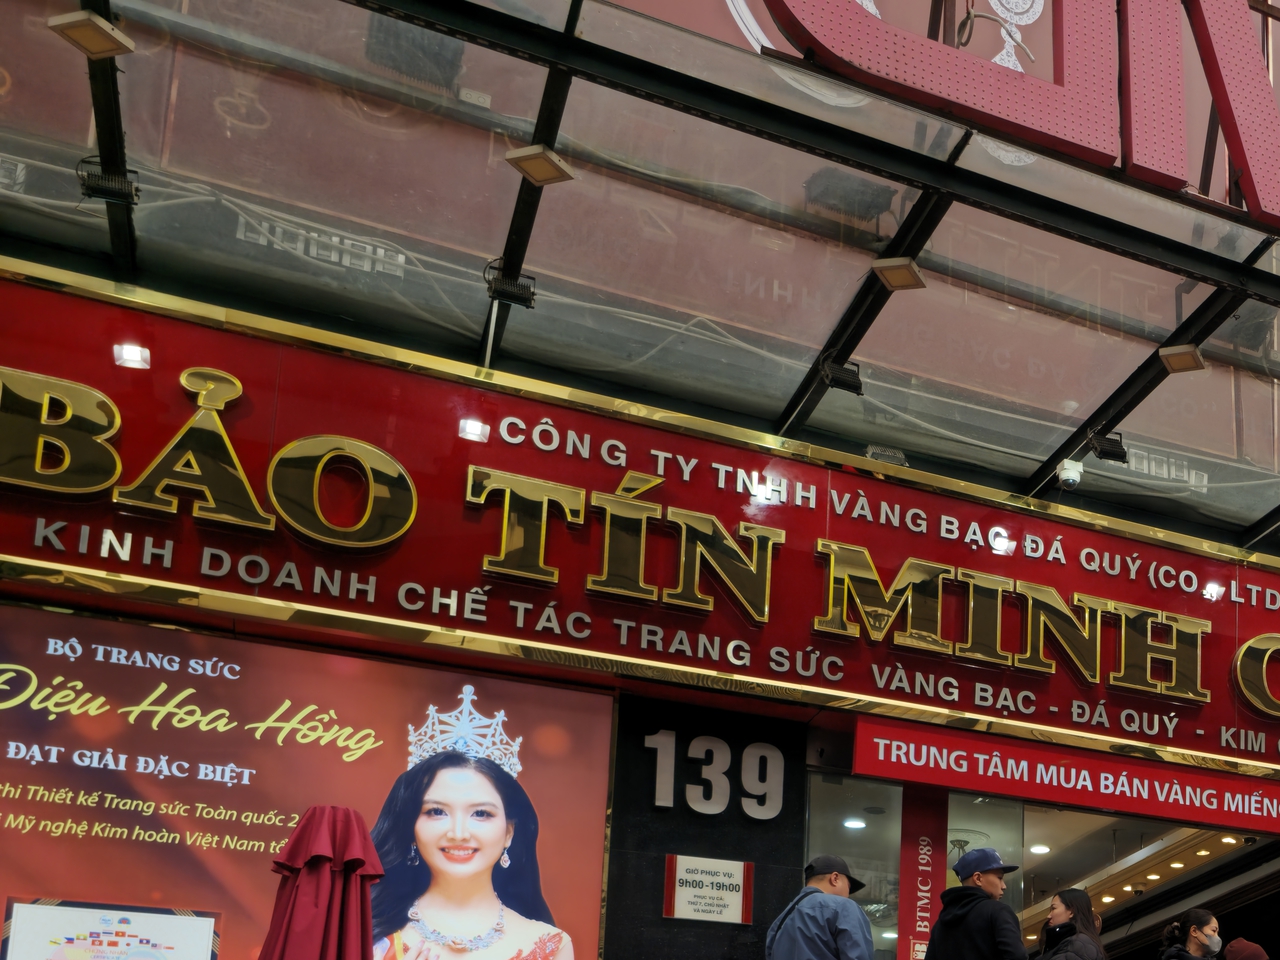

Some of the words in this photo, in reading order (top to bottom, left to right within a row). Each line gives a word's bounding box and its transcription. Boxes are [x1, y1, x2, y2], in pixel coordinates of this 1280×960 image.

[500, 416, 627, 468] CÔNG
[650, 448, 699, 482] TY
[711, 461, 817, 510] TNHH
[830, 489, 928, 534] VÀNG
[939, 513, 1011, 556] BẠC
[1023, 534, 1067, 565] ĐÁ
[1079, 547, 1143, 580] QUÝ
[0, 366, 419, 549] BẢO
[466, 464, 786, 625] TÍN
[813, 537, 1212, 703] MINH
[32, 517, 175, 570] KINH
[200, 548, 378, 604] DOANH
[397, 581, 491, 623] CHẾ
[509, 599, 593, 640] TÁC
[613, 618, 752, 667] TRANG
[769, 644, 846, 682] SỨC
[871, 661, 960, 702] VÀNG
[974, 681, 1037, 717] BẠC
[1071, 699, 1110, 729] ĐÁ
[1120, 708, 1180, 739] QUÝ
[1220, 725, 1267, 754] KIM
[46, 638, 84, 661] BỘ
[92, 644, 181, 672] TRANG
[188, 656, 242, 681] SỨC
[117, 682, 238, 735] Hoa
[244, 698, 384, 763] Hồng
[7, 740, 65, 767] ĐẠT
[72, 748, 128, 772] GIẢI
[136, 755, 190, 780] ĐẶC
[197, 762, 257, 788] BIỆT
[644, 729, 785, 821] 139
[873, 737, 969, 773] TRUNG
[973, 750, 1030, 783] TÂM
[1036, 763, 1094, 792] MUA
[1099, 764, 1151, 801] BÁN
[1154, 776, 1219, 811] VÀNG
[4, 813, 36, 834] Mỹ
[38, 819, 89, 839] nghệ
[92, 823, 128, 840] Kim
[132, 824, 181, 845] hoàn
[186, 831, 221, 850] Việt
[223, 835, 265, 853] Nam
[27, 785, 73, 804] Thiết
[77, 790, 102, 807] kế
[104, 793, 156, 816] Trang
[159, 800, 191, 817] sức
[195, 803, 238, 821] Toàn
[241, 810, 286, 827] quốc
[685, 867, 699, 875] GIỜ
[700, 869, 721, 877] PHỤC
[917, 835, 934, 873] 1989
[915, 876, 932, 934] BTMC
